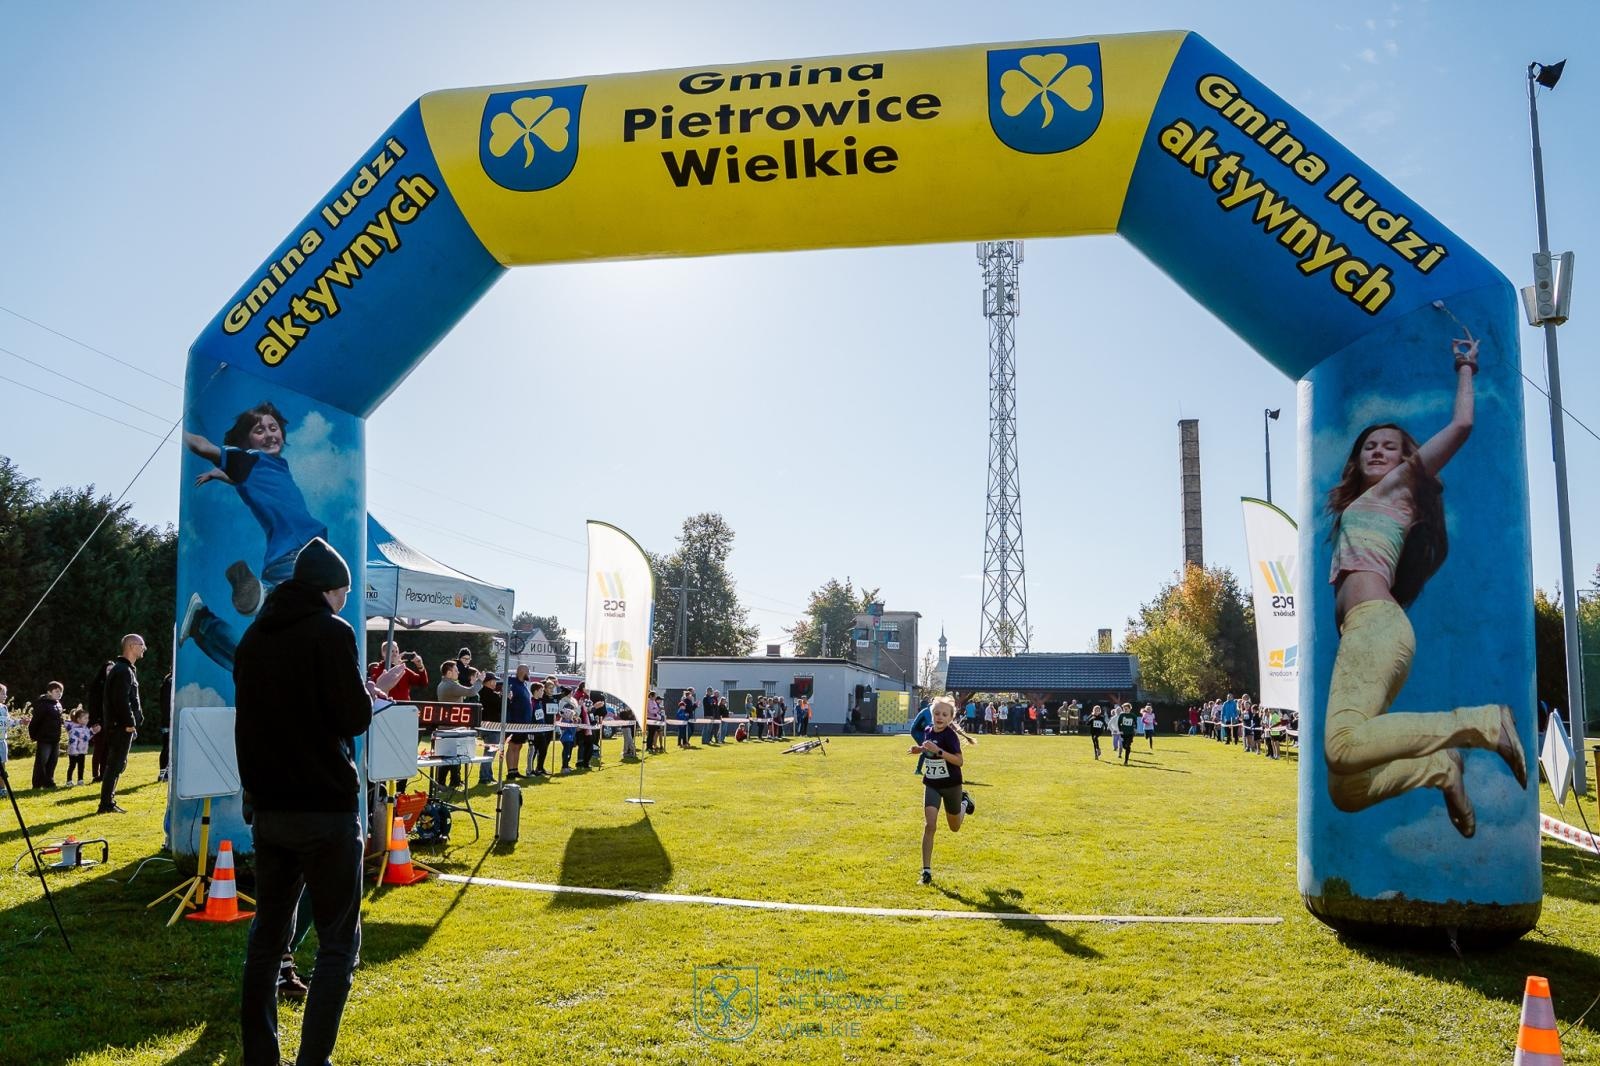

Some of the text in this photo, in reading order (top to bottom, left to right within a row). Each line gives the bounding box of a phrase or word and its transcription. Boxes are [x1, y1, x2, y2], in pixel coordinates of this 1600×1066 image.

[623, 88, 942, 143] Pietrowice
[679, 63, 884, 95] Gmina
[660, 135, 899, 188] Wielkie
[1159, 118, 1395, 315] aktywnych
[1196, 74, 1448, 274] Gmina ludzi
[222, 137, 407, 334] Gmina ludzi
[256, 174, 438, 367] aktywnych
[925, 765, 946, 775] 273
